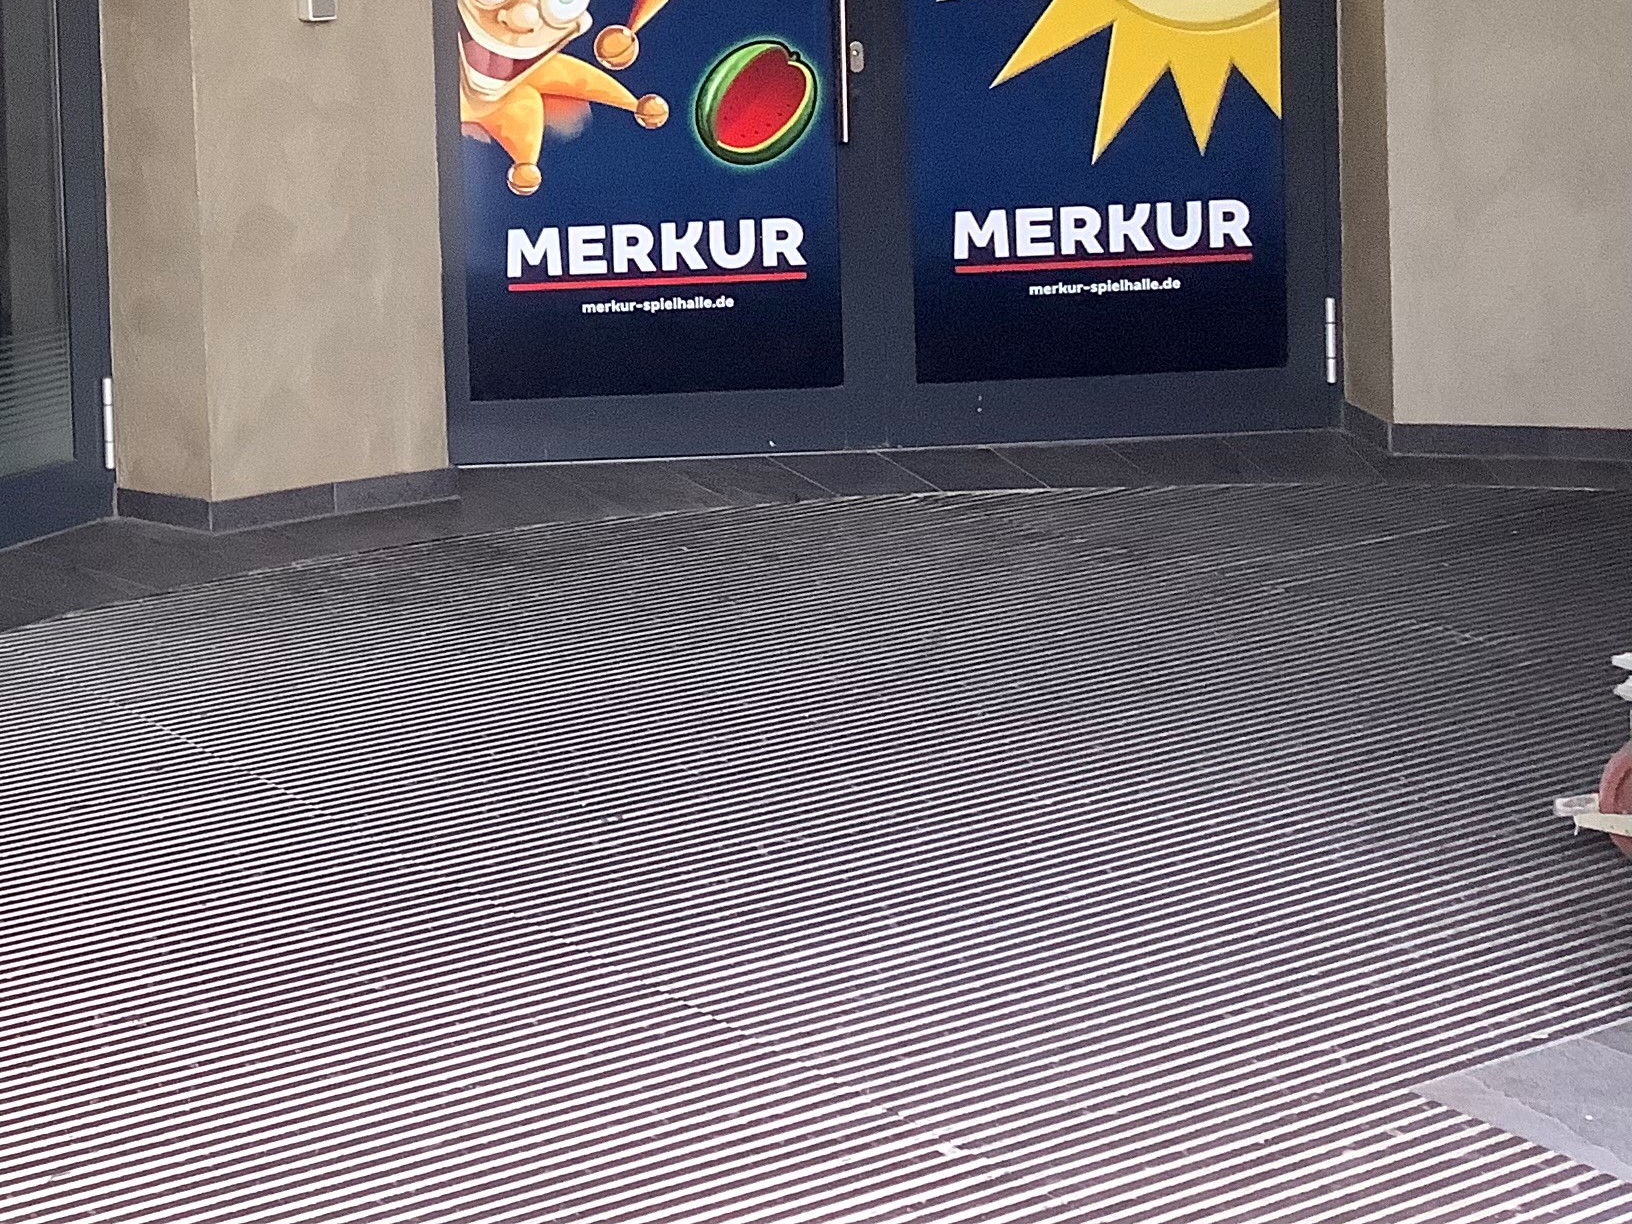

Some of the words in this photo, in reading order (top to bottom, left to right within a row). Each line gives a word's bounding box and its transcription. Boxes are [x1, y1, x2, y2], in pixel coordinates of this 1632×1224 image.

[507, 217, 808, 278] MERKUR
[953, 198, 1253, 260] MERKUR
[581, 295, 735, 315] merkur-spielhalle.de
[1028, 276, 1182, 296] merkur-spielhalle.de
